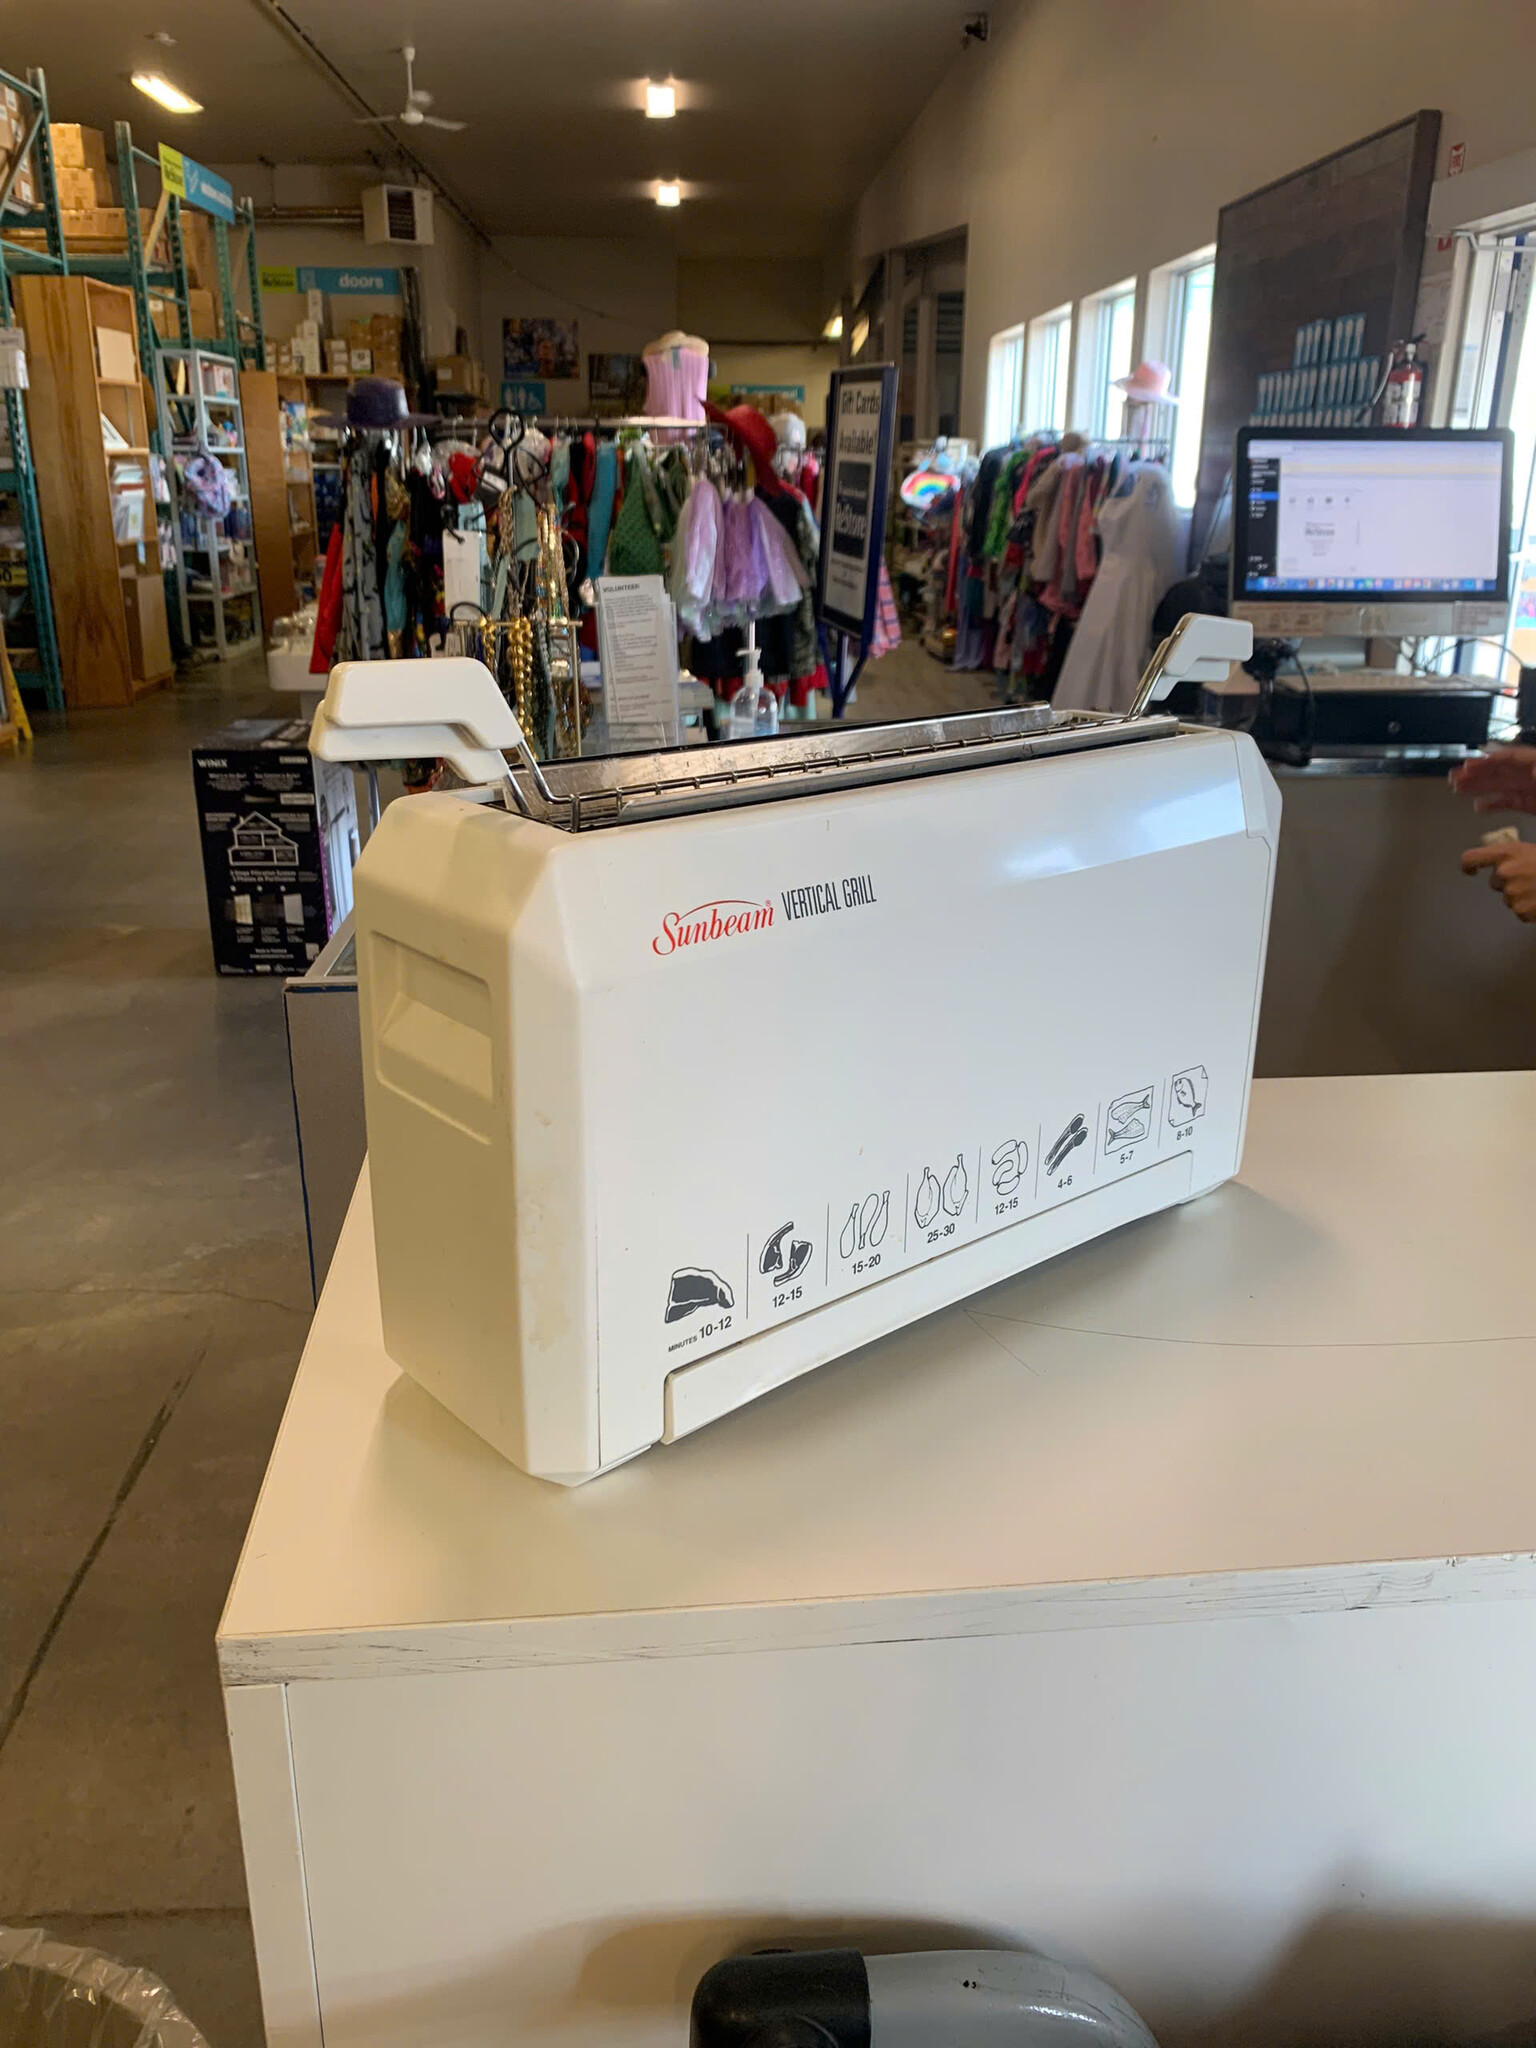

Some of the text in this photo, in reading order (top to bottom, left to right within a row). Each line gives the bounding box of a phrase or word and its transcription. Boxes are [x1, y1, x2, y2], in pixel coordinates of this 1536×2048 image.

[339, 274, 384, 289] doors
[857, 389, 880, 414] Cards
[603, 583, 640, 592] VOLUNTEER
[197, 758, 227, 768] WINIX
[781, 874, 877, 921] VERTICAL GRILL
[652, 900, 774, 955] Sunbeam
[1176, 1126, 1193, 1140] 8-10
[1119, 1150, 1134, 1164] 5-7
[1057, 1175, 1073, 1189] 4-6
[994, 1197, 1019, 1215] 12-15
[926, 1223, 955, 1244] 25-30
[851, 1253, 882, 1275] 15-20
[772, 1286, 803, 1308] 12-15
[667, 1315, 732, 1353] MINUTES 10-12
